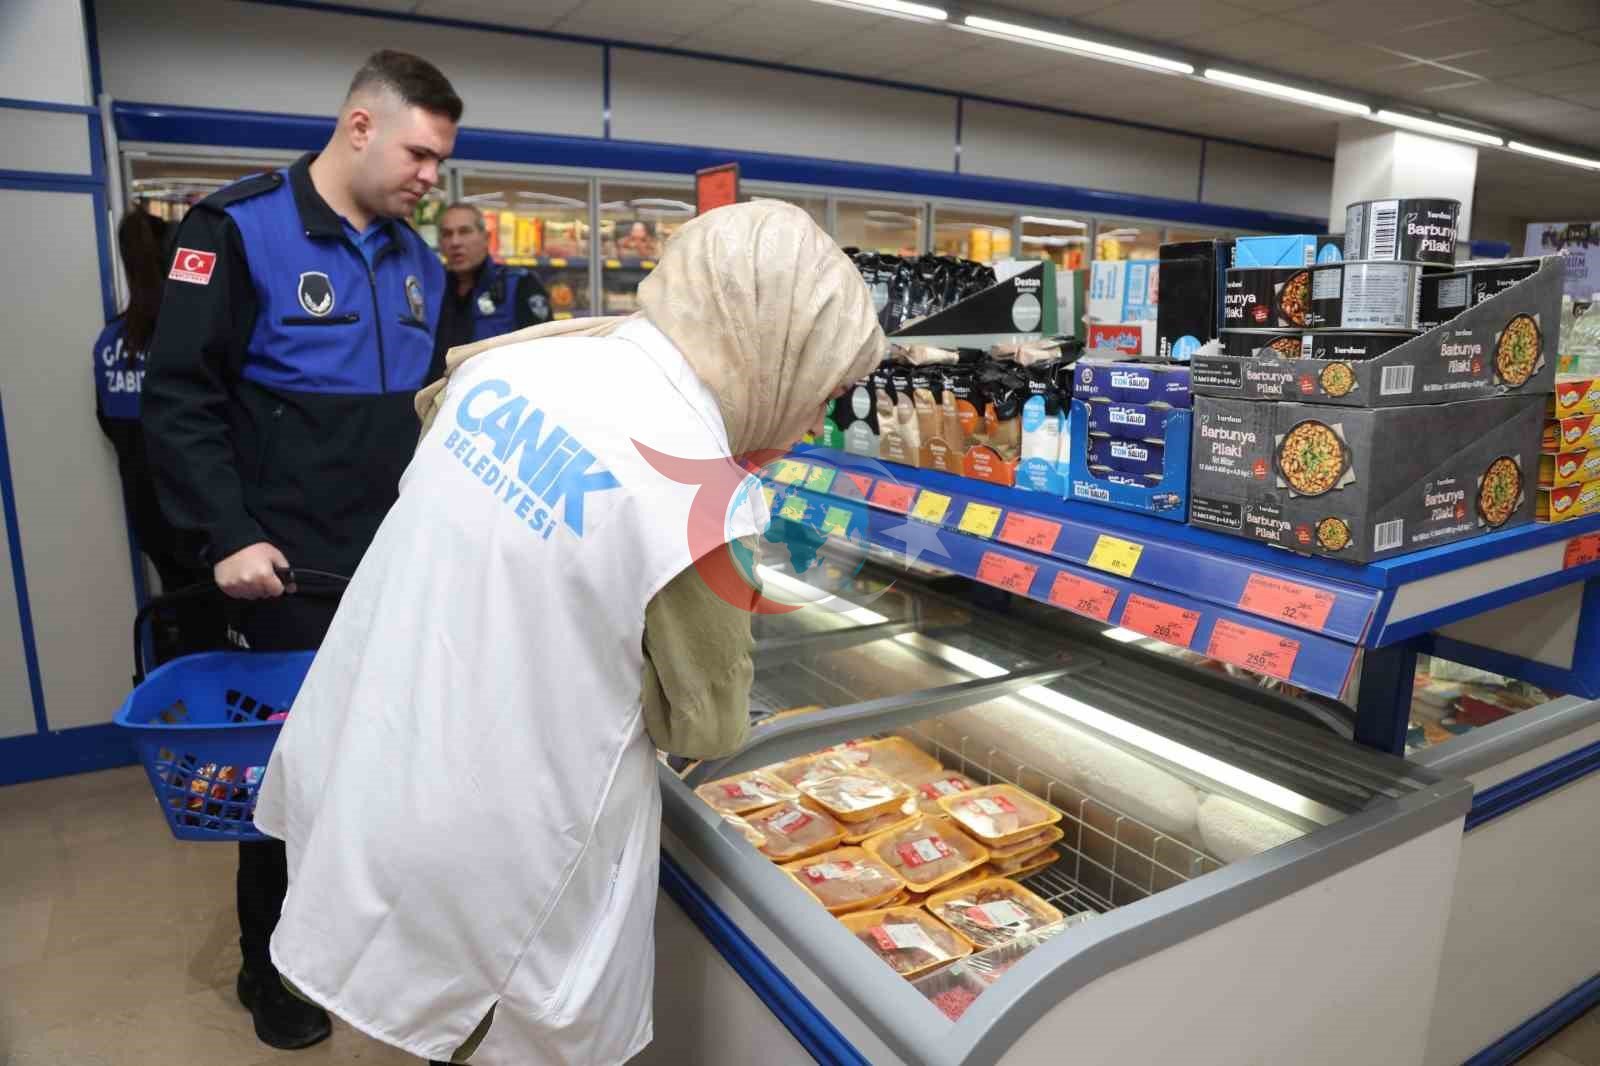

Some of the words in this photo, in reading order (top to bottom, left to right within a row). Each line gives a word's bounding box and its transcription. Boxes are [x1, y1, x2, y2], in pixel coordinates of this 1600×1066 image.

[1408, 223, 1456, 241] Barbuny
[1422, 240, 1451, 253] Pilaki
[1440, 343, 1481, 359] Barbunya
[1448, 359, 1471, 374] Pilaki
[1247, 370, 1293, 385] Barbunya
[1257, 383, 1283, 394] Pilaki
[1201, 424, 1256, 446] Barbunya
[1212, 441, 1242, 458] Pilaki
[443, 428, 557, 540] BELEDİYESİ
[1425, 490, 1465, 507] Barbunya
[1246, 513, 1292, 531] Barbunya
[1255, 527, 1281, 541] Pilaki
